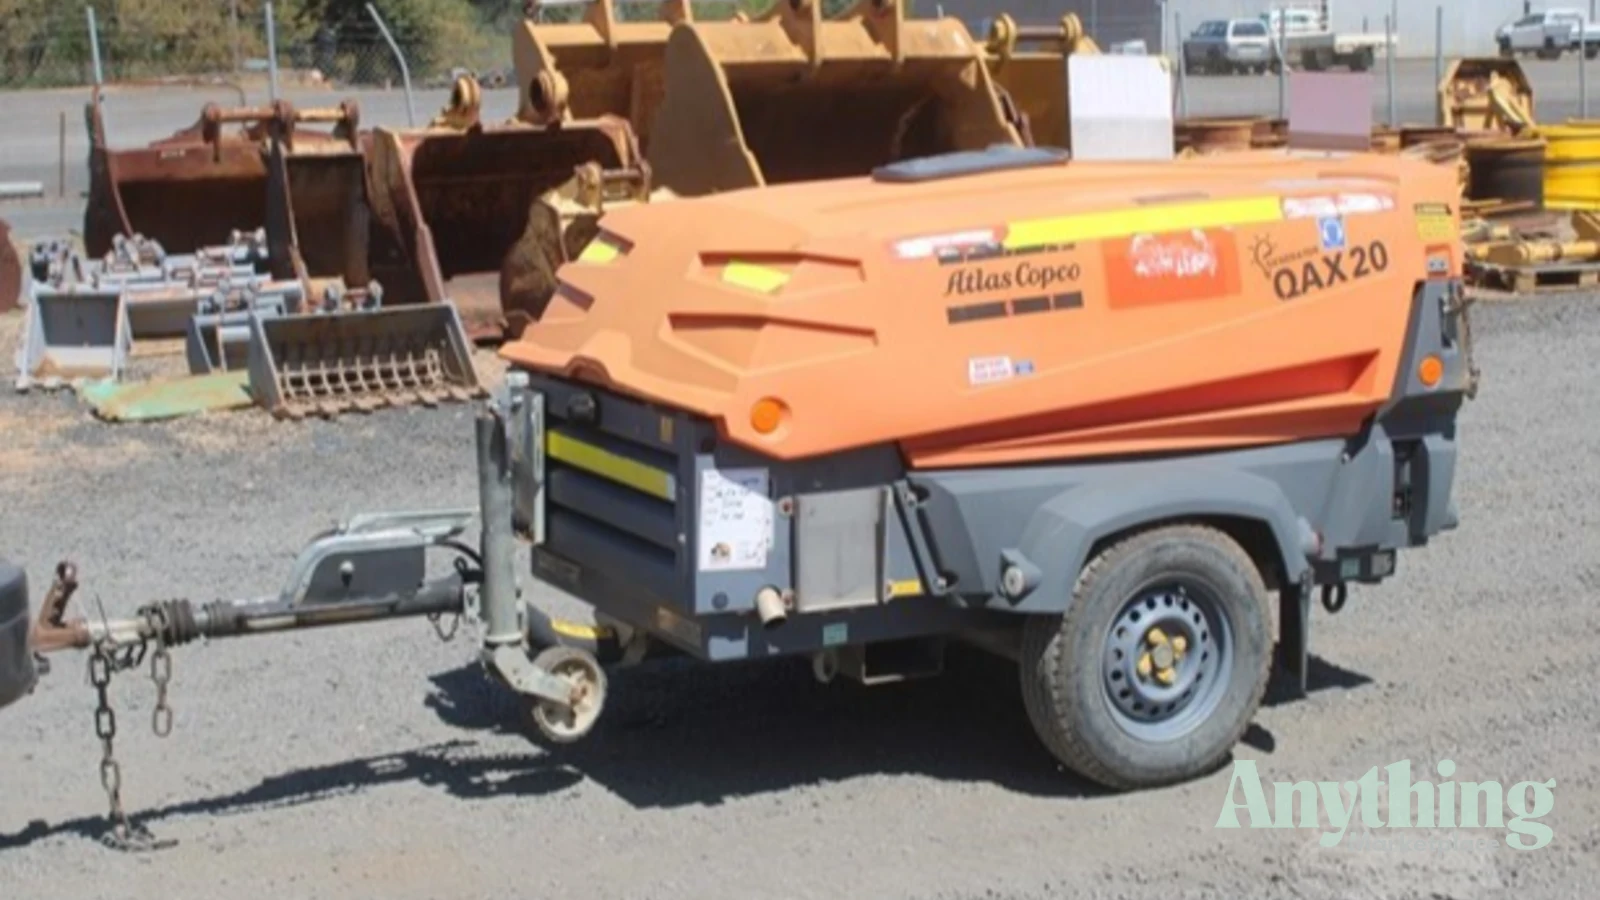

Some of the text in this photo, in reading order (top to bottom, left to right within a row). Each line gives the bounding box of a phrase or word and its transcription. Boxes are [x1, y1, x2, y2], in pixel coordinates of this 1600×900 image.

[944, 262, 1081, 297] Atlas Copco
[1273, 239, 1388, 301] QAX 20
